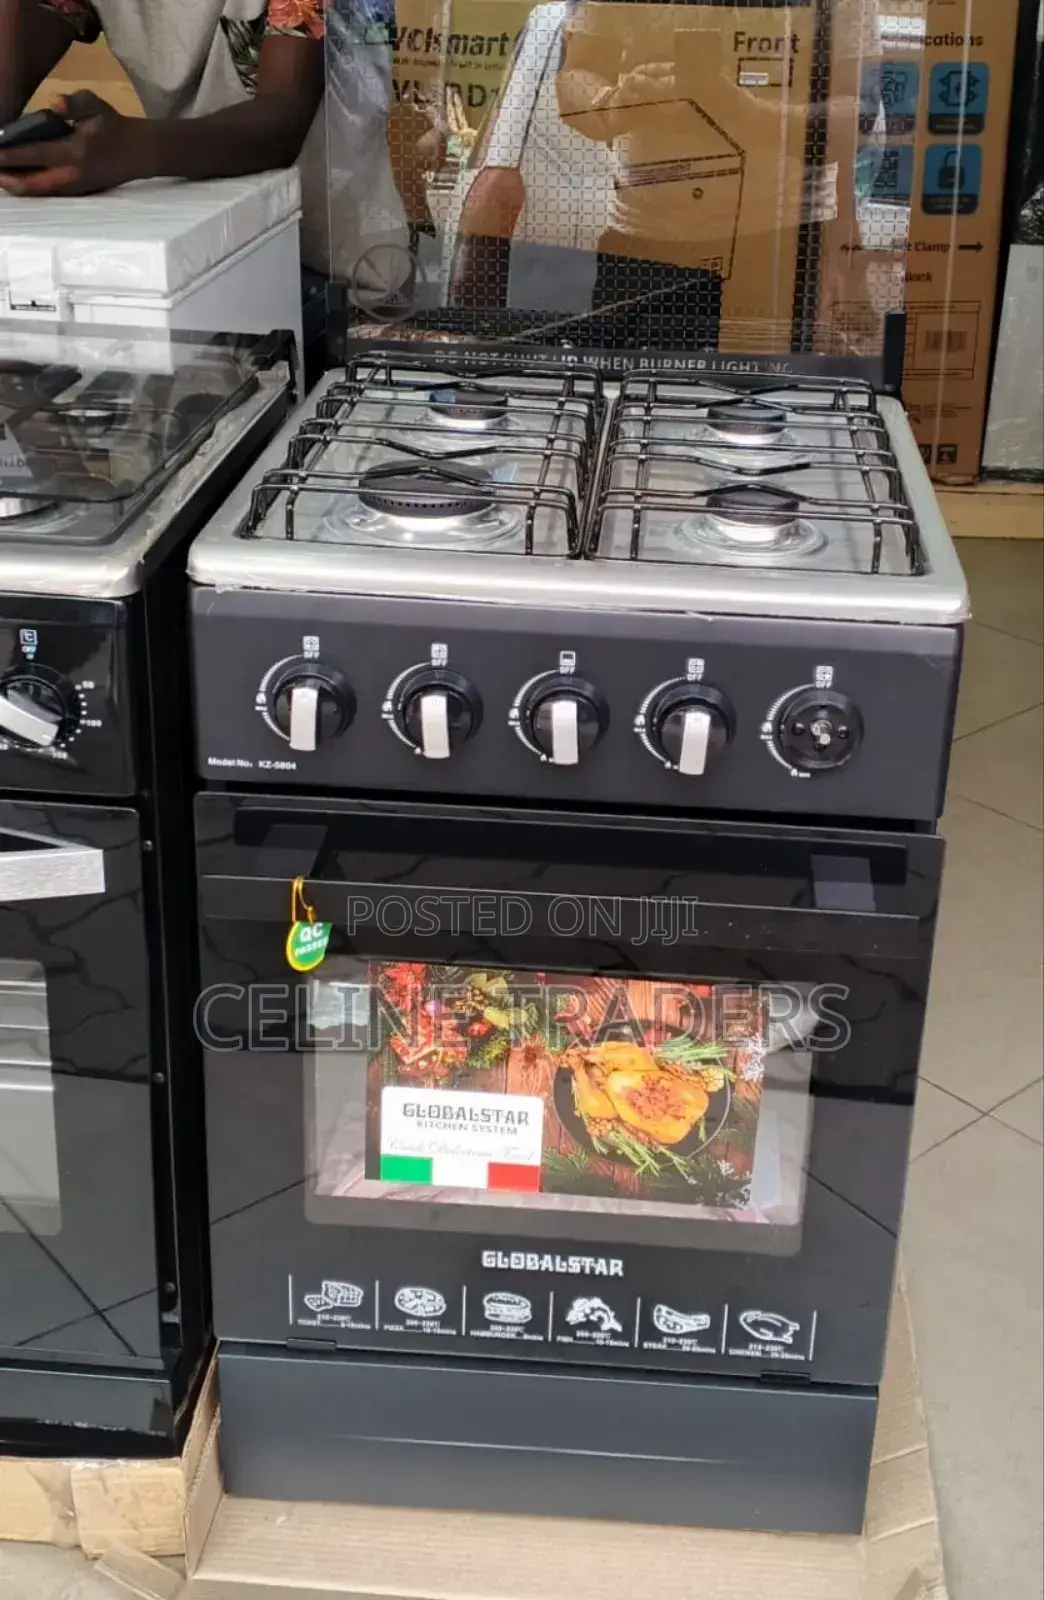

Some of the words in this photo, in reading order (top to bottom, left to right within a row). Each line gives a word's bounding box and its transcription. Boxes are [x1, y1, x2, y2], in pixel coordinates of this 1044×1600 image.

[733, 31, 800, 53] Front
[583, 355, 634, 370] WHEN
[208, 756, 236, 767] Model
[300, 922, 324, 942] QC
[402, 1102, 530, 1126] GLOBALSTAR
[416, 1120, 468, 1132] KITCHEN
[471, 1124, 518, 1136] SYSTEM
[481, 1250, 625, 1278] GLOBALSTAR
